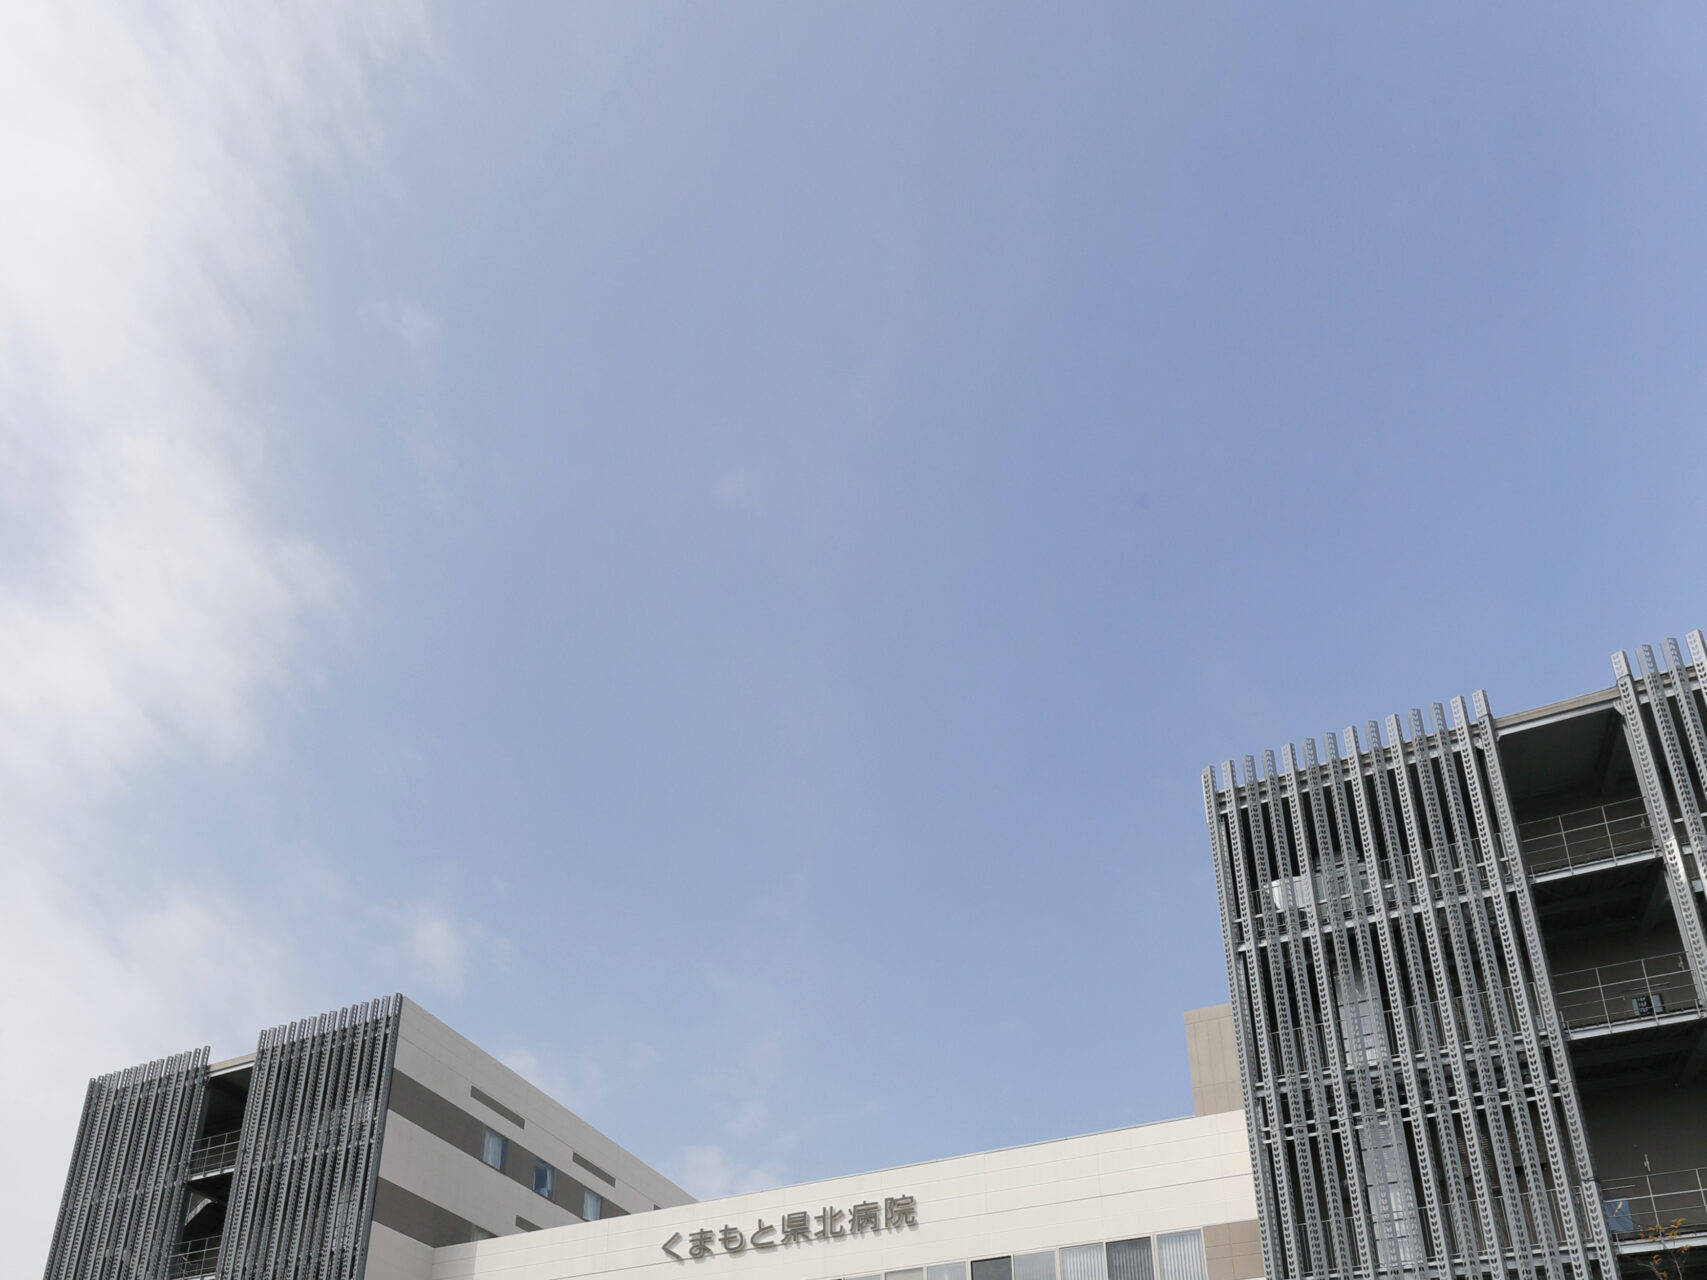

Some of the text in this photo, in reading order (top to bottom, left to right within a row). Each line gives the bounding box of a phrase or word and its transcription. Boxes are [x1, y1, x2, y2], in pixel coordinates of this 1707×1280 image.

[661, 1194, 918, 1260] くまもと県北病院
